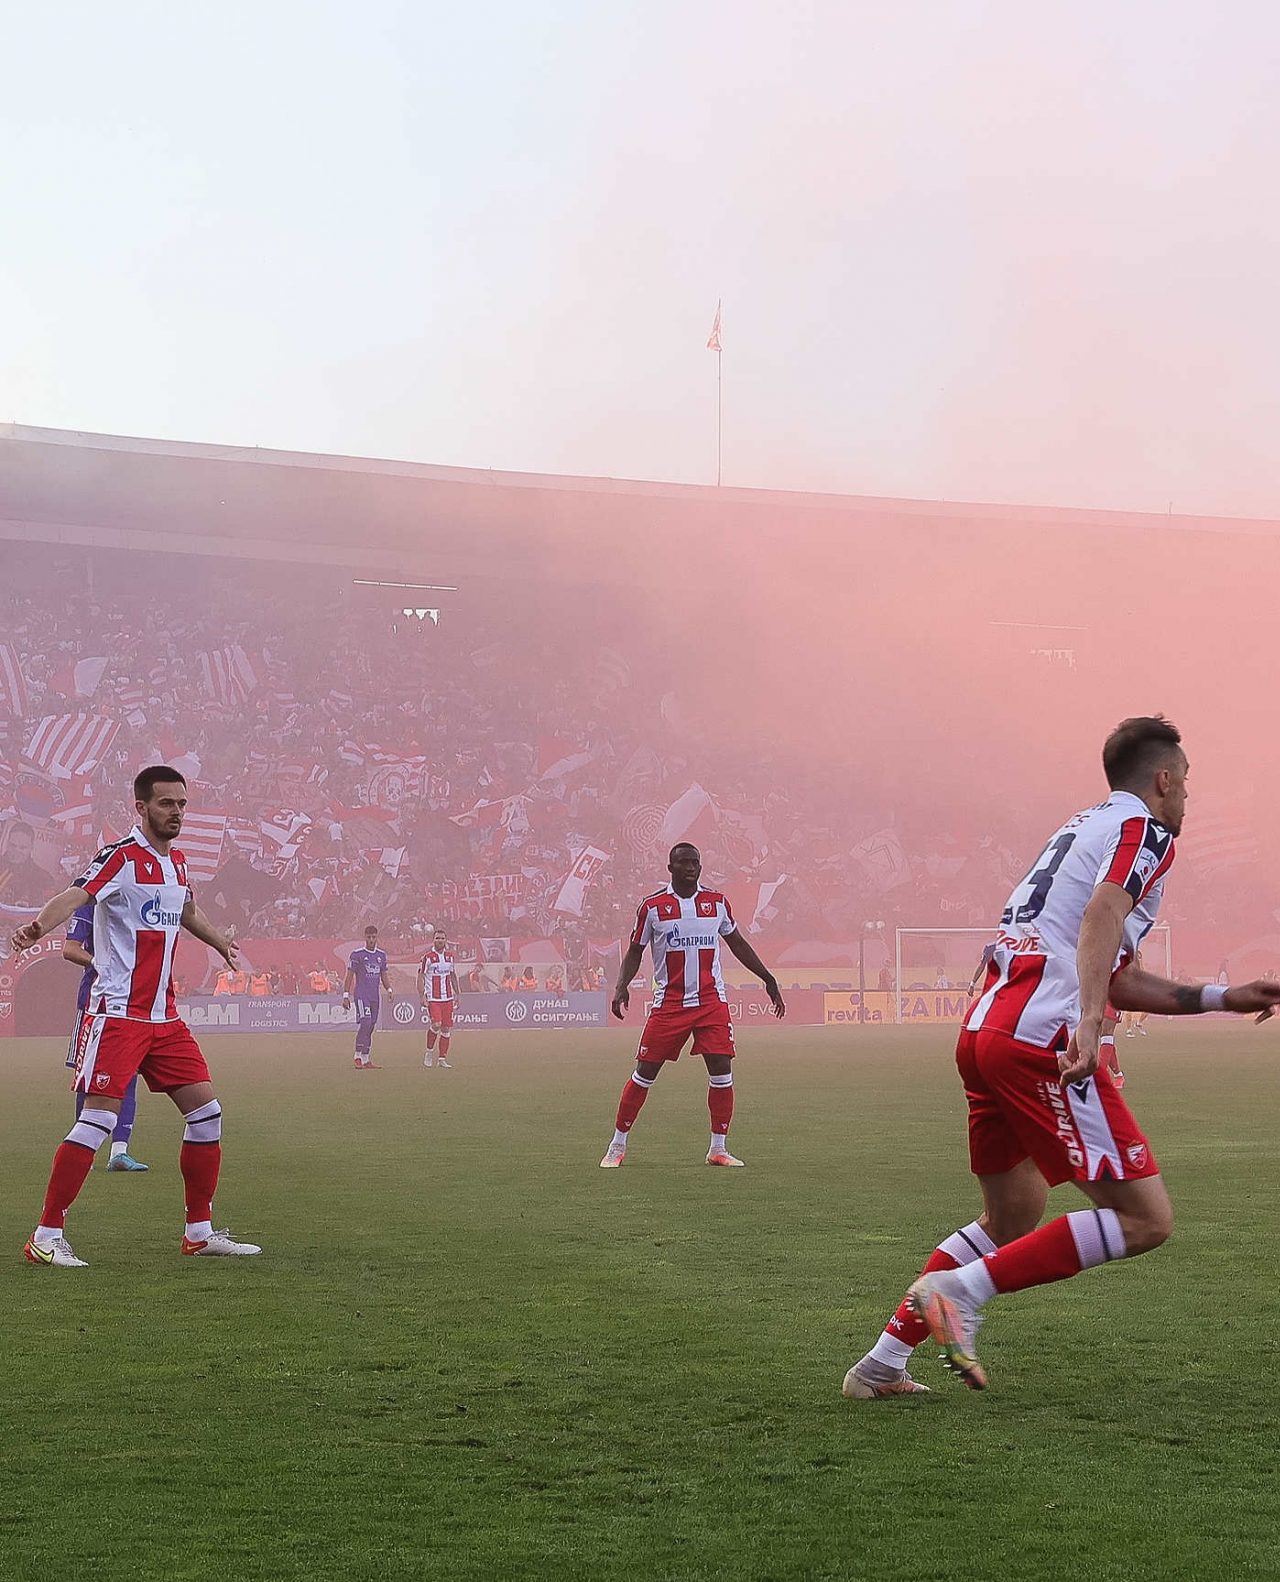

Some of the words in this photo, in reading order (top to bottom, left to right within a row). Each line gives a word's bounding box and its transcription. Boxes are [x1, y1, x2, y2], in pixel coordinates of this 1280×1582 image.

[45, 940, 62, 952] JE
[681, 935, 715, 947] GAZPROM
[248, 1001, 292, 1009] TRANSPORT
[532, 1000, 569, 1009] ДУНАВ
[532, 1013, 600, 1023] ОСИГУРАЊЕ
[827, 1009, 883, 1022] revita
[250, 1020, 289, 1028] LOGISTICS
